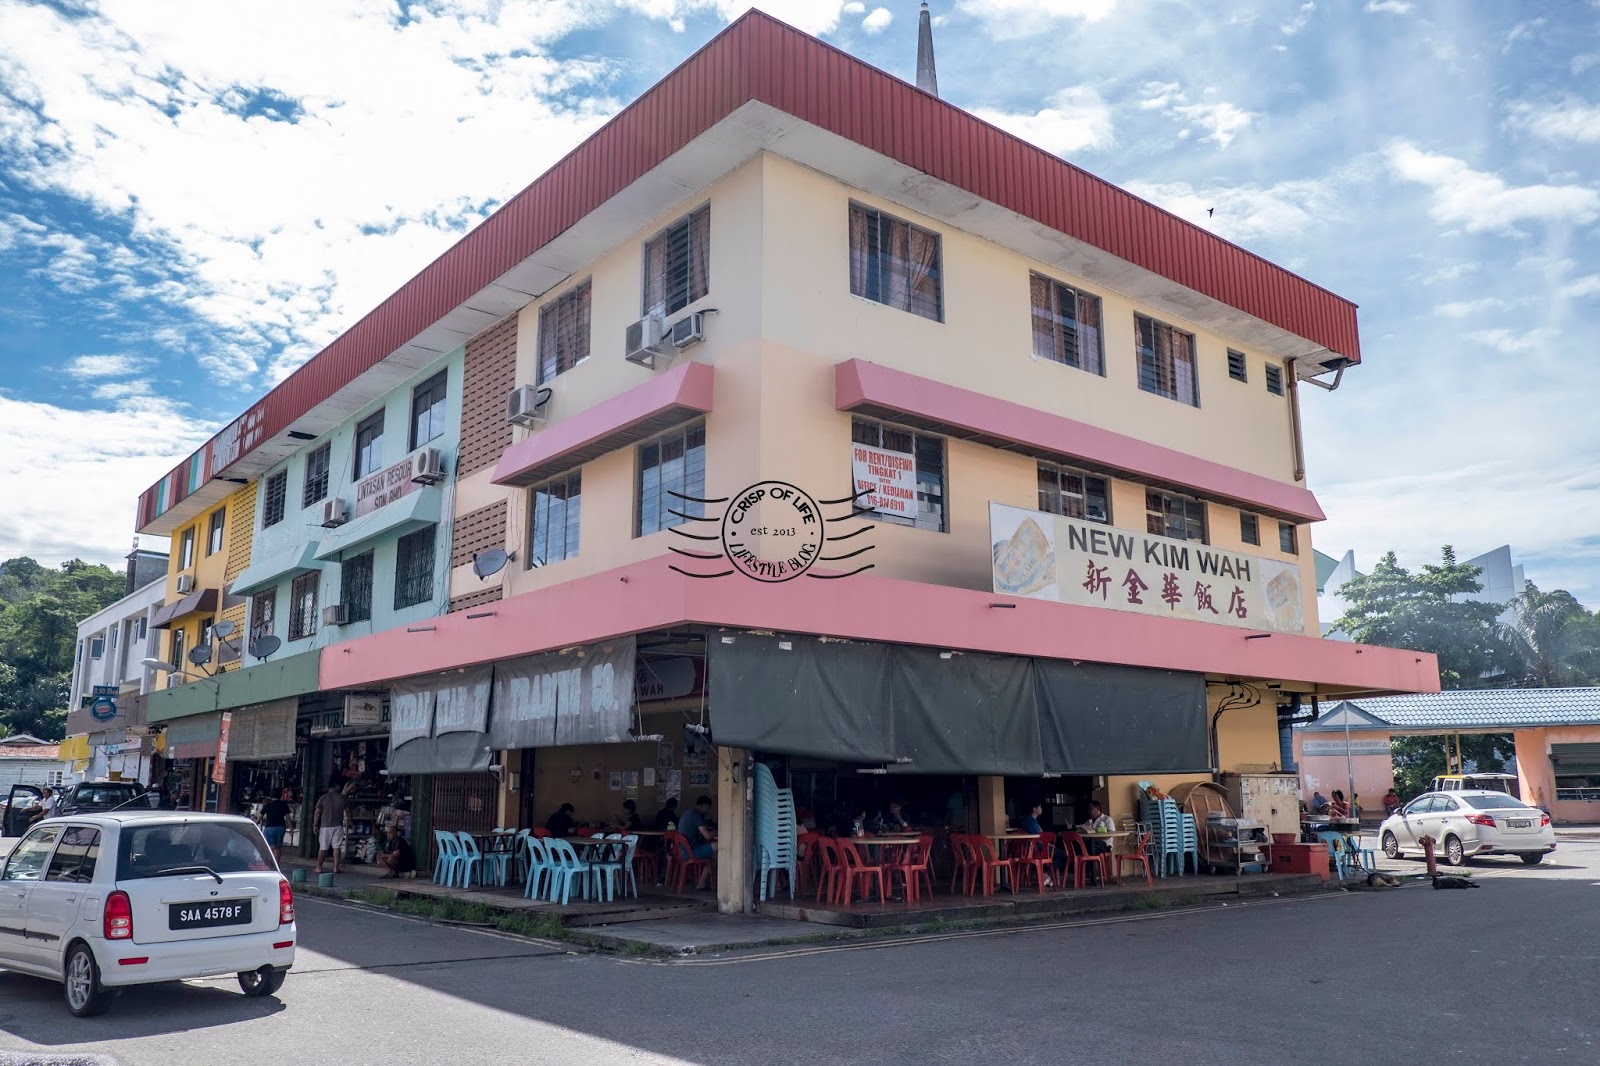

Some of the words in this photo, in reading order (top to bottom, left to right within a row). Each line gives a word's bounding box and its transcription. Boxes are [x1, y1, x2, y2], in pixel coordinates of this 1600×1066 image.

[854, 448, 867, 463] FOR
[869, 451, 913, 472] RENT/DISEWA
[387, 461, 412, 487] RESOUR
[868, 464, 897, 479] TINGKAT
[898, 470, 902, 480] 1
[857, 479, 877, 493] OFFICE
[883, 484, 913, 500] KEDIAMAN
[1068, 524, 1134, 560] NEW
[1143, 539, 1190, 571] KIM
[1196, 549, 1251, 582] WAH
[1082, 559, 1248, 619] 新金華飯店
[640, 684, 664, 696] WAH
[180, 909, 201, 921] SAA
[204, 907, 232, 919] 4578
